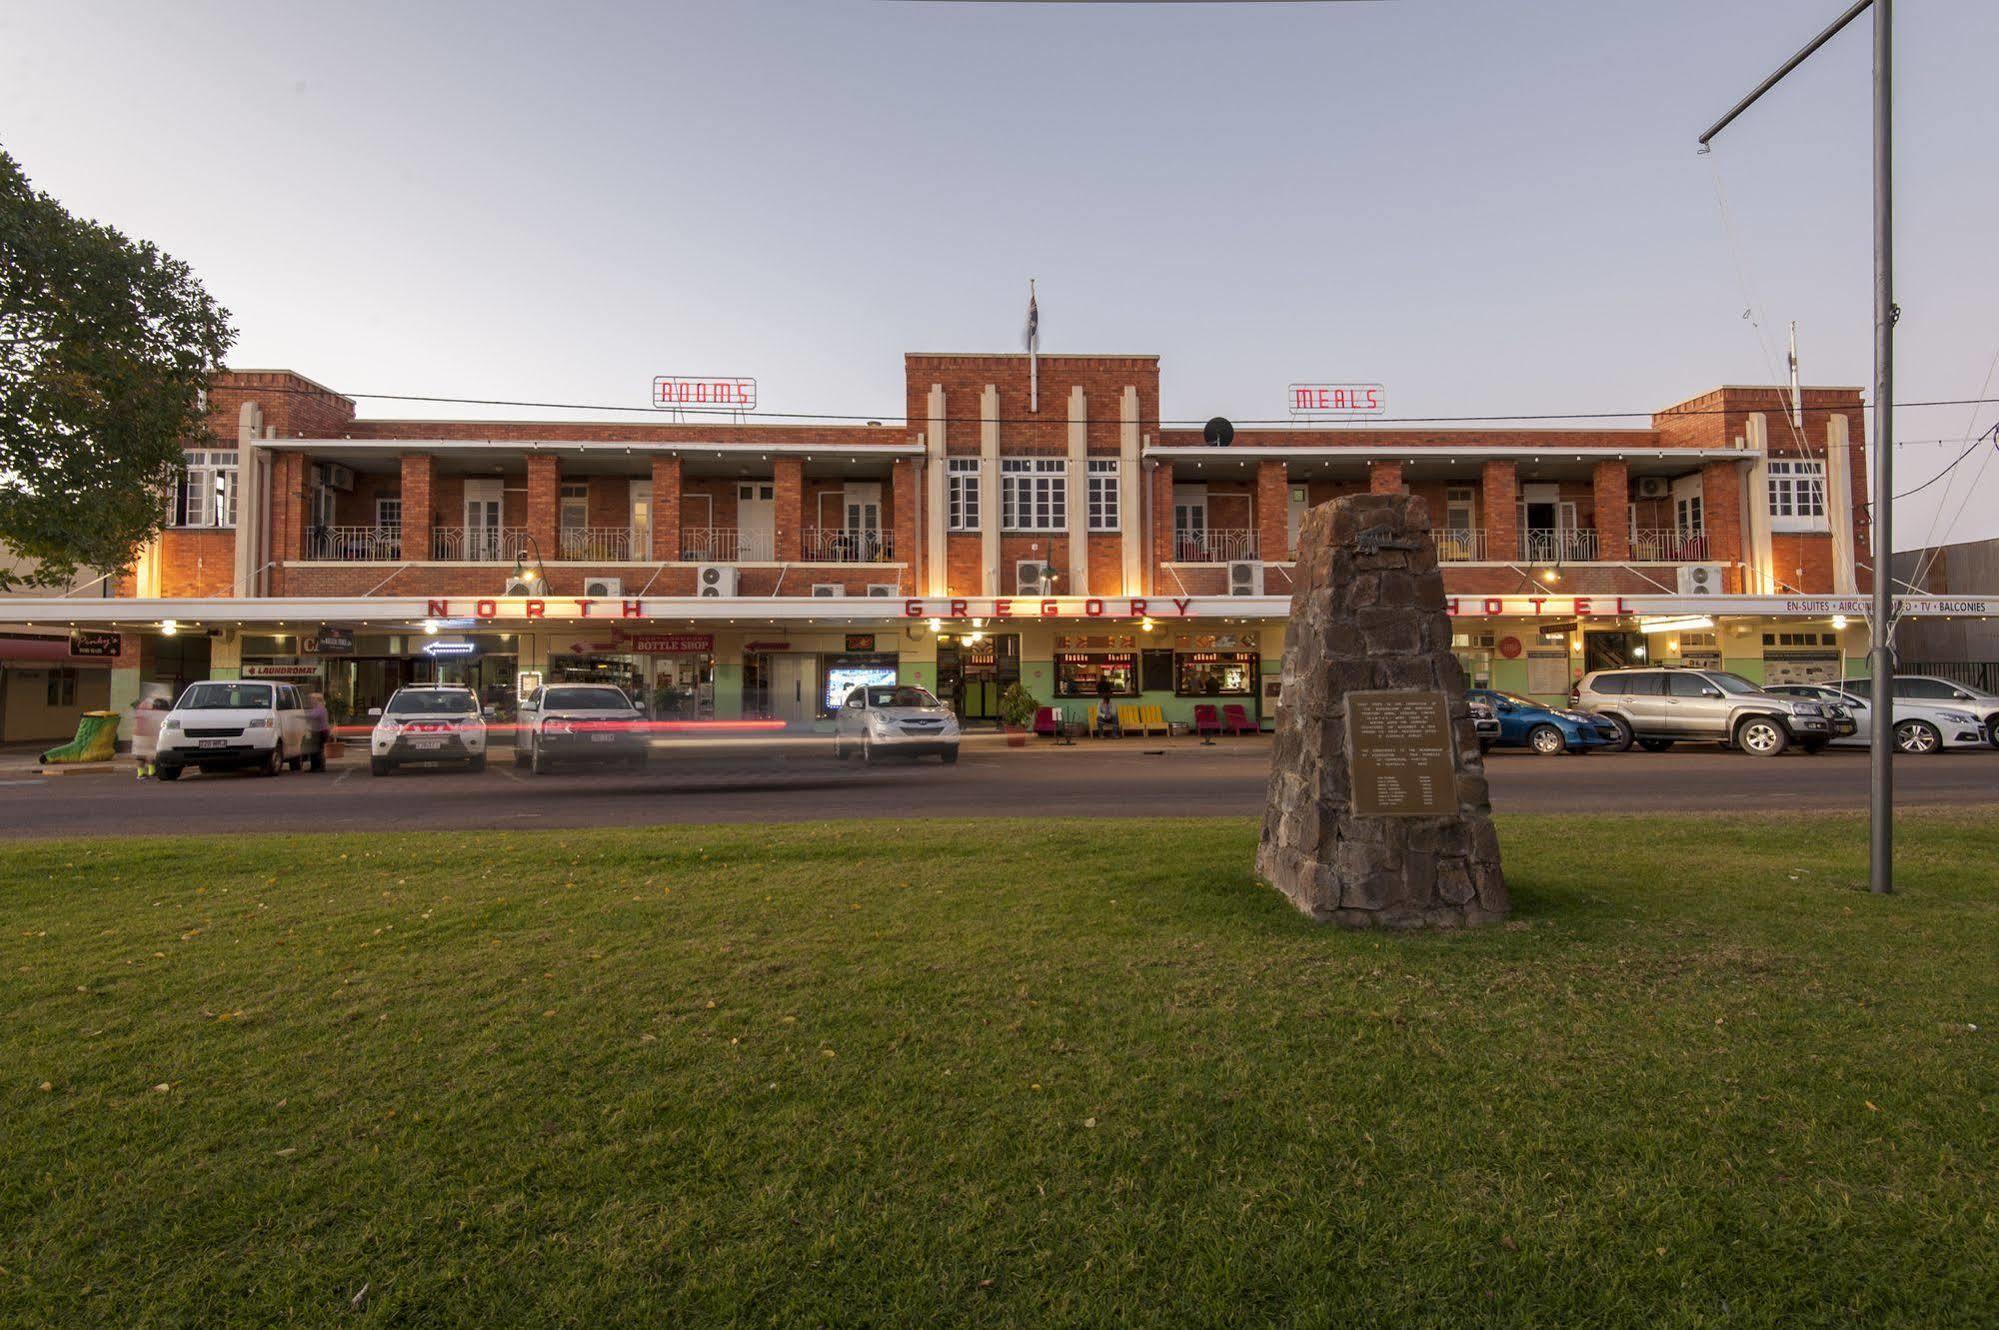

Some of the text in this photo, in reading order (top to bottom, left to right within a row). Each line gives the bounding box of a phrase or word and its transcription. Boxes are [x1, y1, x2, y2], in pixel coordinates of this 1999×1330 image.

[662, 382, 747, 403] ROOMS
[1296, 389, 1377, 409] MEALS
[428, 600, 641, 618] NORTH
[905, 598, 1191, 617] GREGORY
[1787, 601, 1830, 611] EN-SUITES
[1920, 602, 1931, 611] TV
[1939, 602, 1986, 612] BALCONIES
[637, 641, 709, 651] BOTTLE SHOP
[257, 666, 317, 675] LAUNDROMAT
